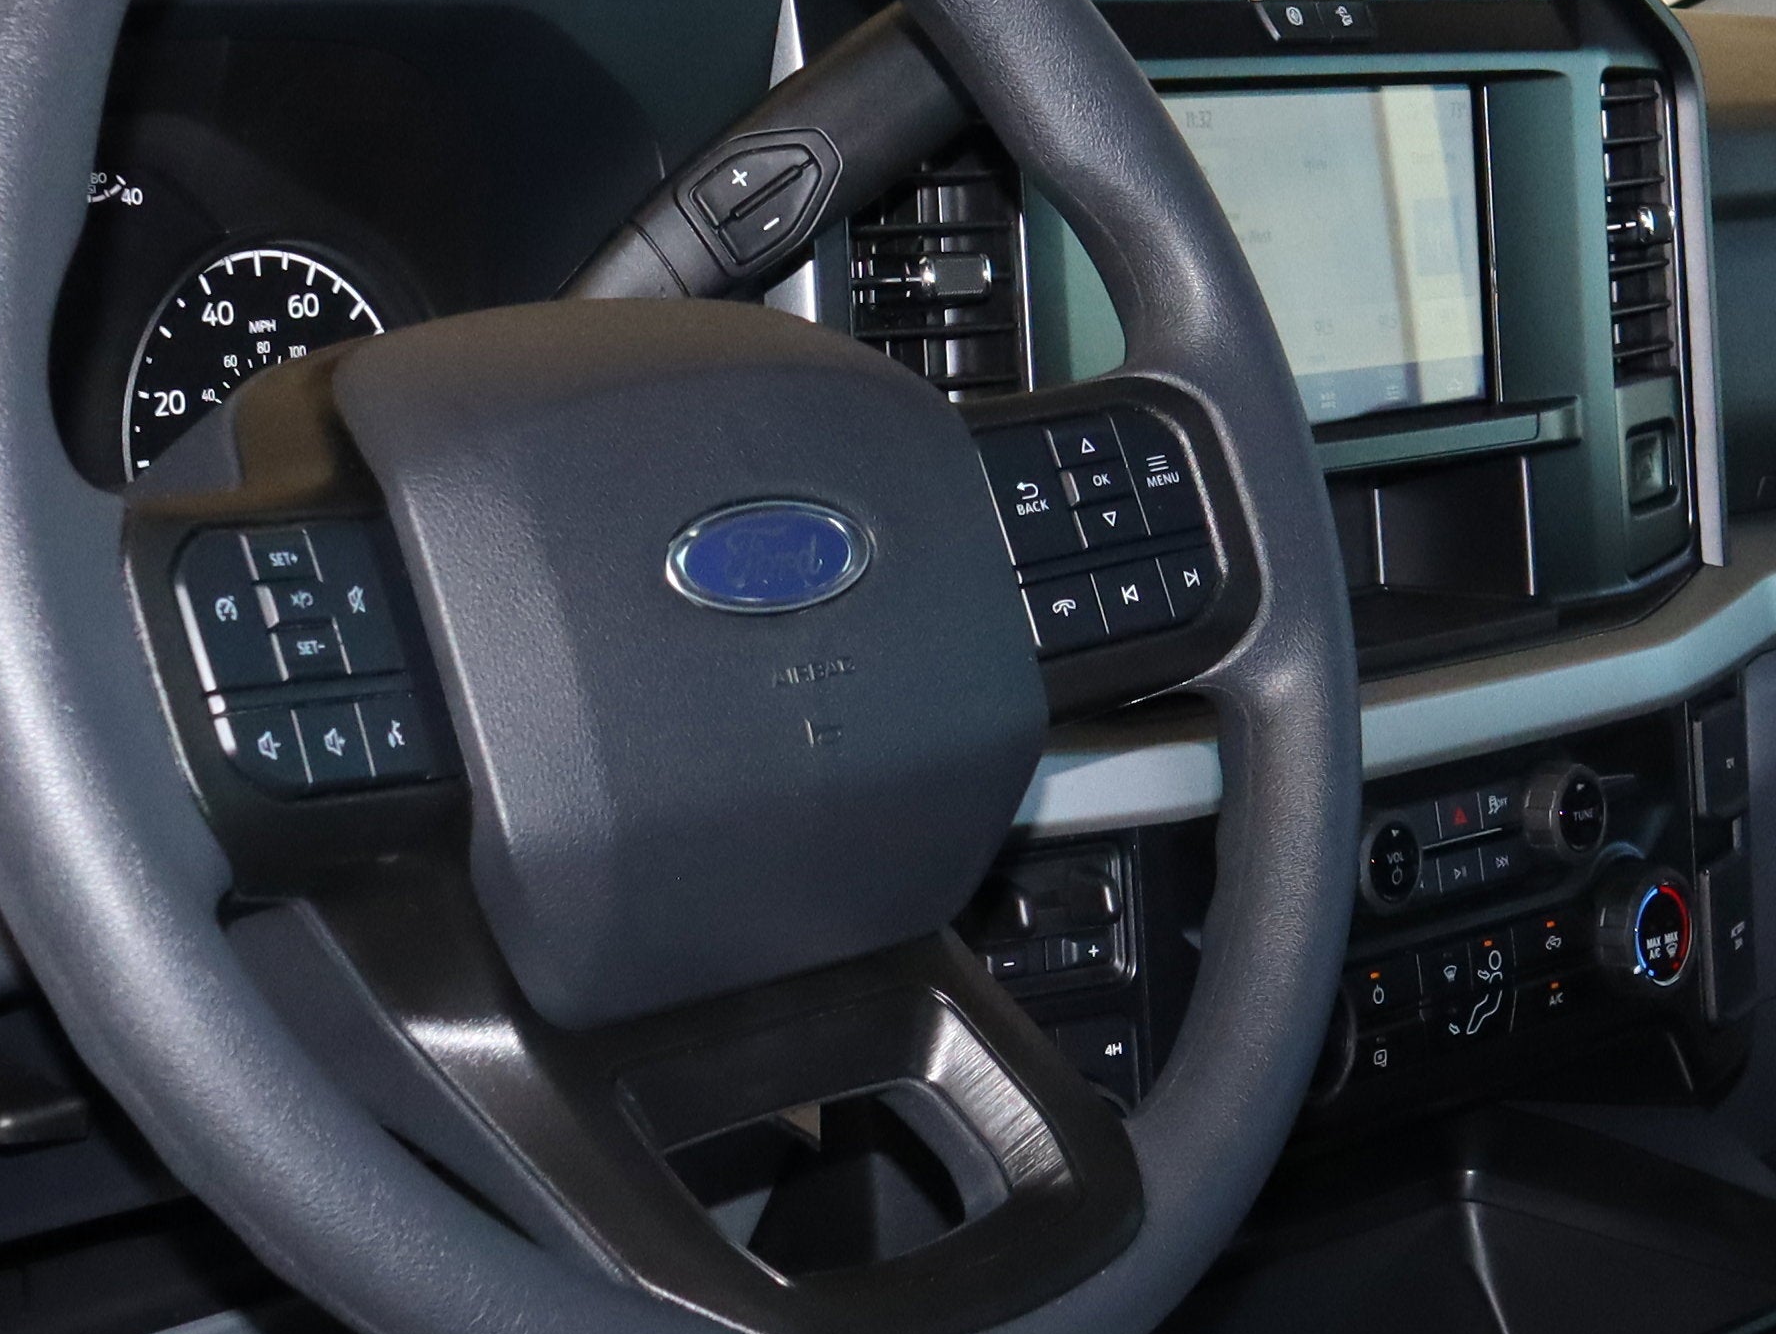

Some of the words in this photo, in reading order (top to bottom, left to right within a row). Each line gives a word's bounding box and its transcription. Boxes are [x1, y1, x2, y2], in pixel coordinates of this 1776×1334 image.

[121, 187, 143, 206] 40
[201, 301, 234, 326] 40
[287, 293, 320, 319] 60
[248, 319, 277, 334] MPH
[256, 341, 271, 355] 80
[288, 345, 307, 359] 100
[223, 354, 238, 368] 60
[201, 388, 215, 402] 40
[154, 389, 186, 417] 20
[1092, 473, 1111, 487] OK
[1147, 471, 1180, 488] MENU
[1016, 499, 1050, 516] BACK
[1387, 852, 1405, 865] VOL
[1104, 1042, 1122, 1057] 4H
